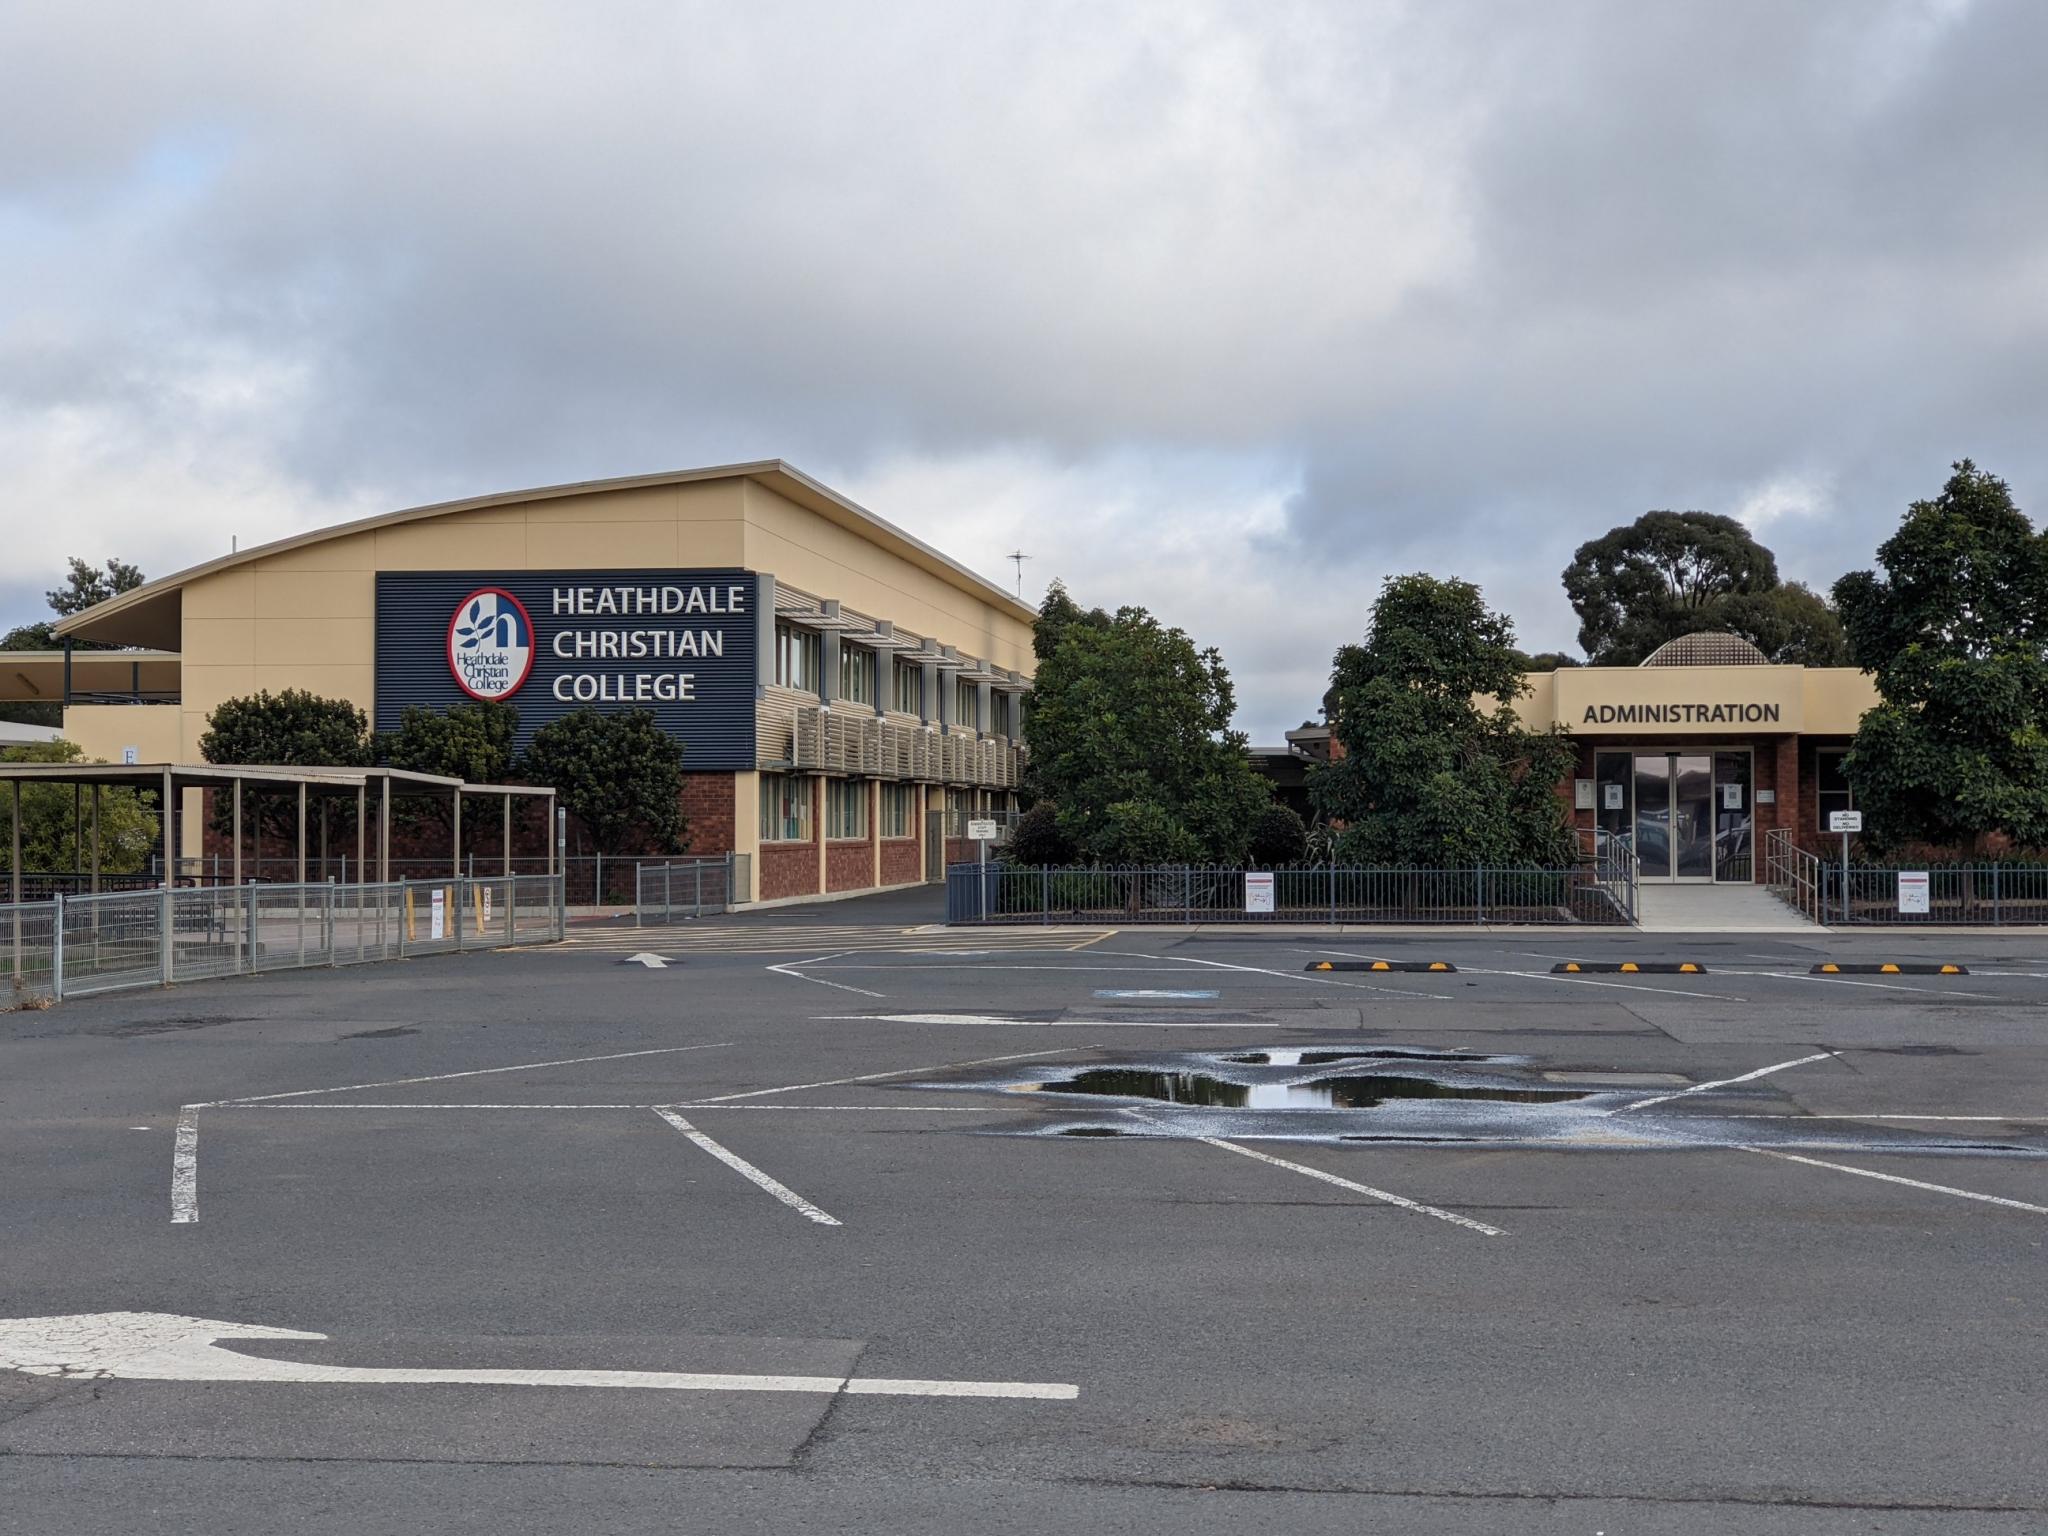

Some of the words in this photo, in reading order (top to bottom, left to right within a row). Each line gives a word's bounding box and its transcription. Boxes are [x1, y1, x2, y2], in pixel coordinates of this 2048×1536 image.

[551, 586, 745, 615] HEATHDALE
[551, 630, 723, 658] CHRISTIAN
[456, 652, 509, 665] Heathdale
[464, 664, 509, 678] Christian
[468, 677, 509, 693] College
[552, 673, 696, 701] COLLEGE
[1583, 703, 1780, 723] ADMINISTRATION
